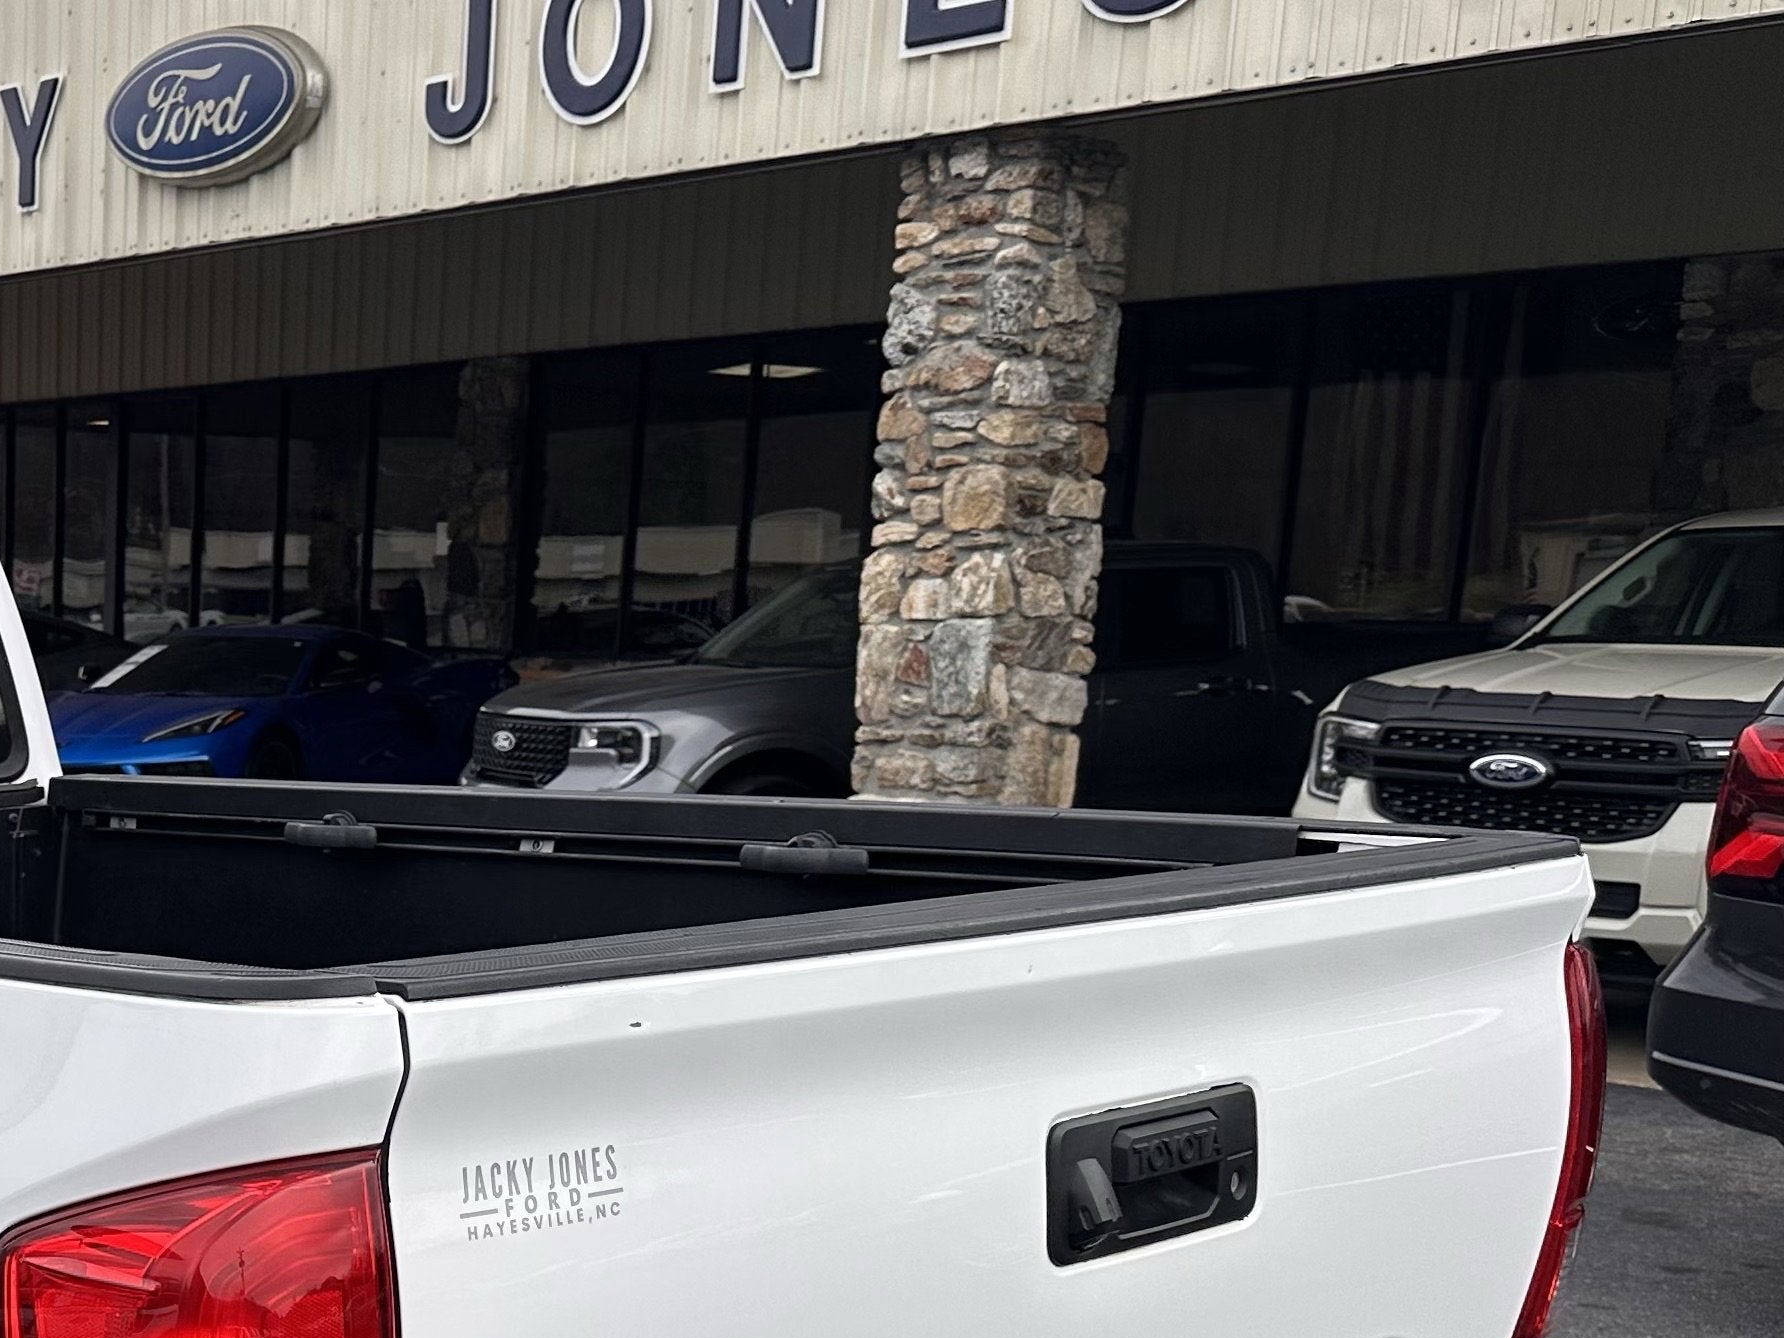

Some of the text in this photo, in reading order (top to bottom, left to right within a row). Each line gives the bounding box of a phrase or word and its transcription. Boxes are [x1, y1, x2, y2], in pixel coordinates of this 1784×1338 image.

[135, 62, 252, 151] Ford
[424, 0, 1196, 146] JON
[462, 1144, 618, 1204] JACKY JONES
[1131, 1126, 1222, 1176] TOYOTA
[504, 1187, 582, 1218] FORD
